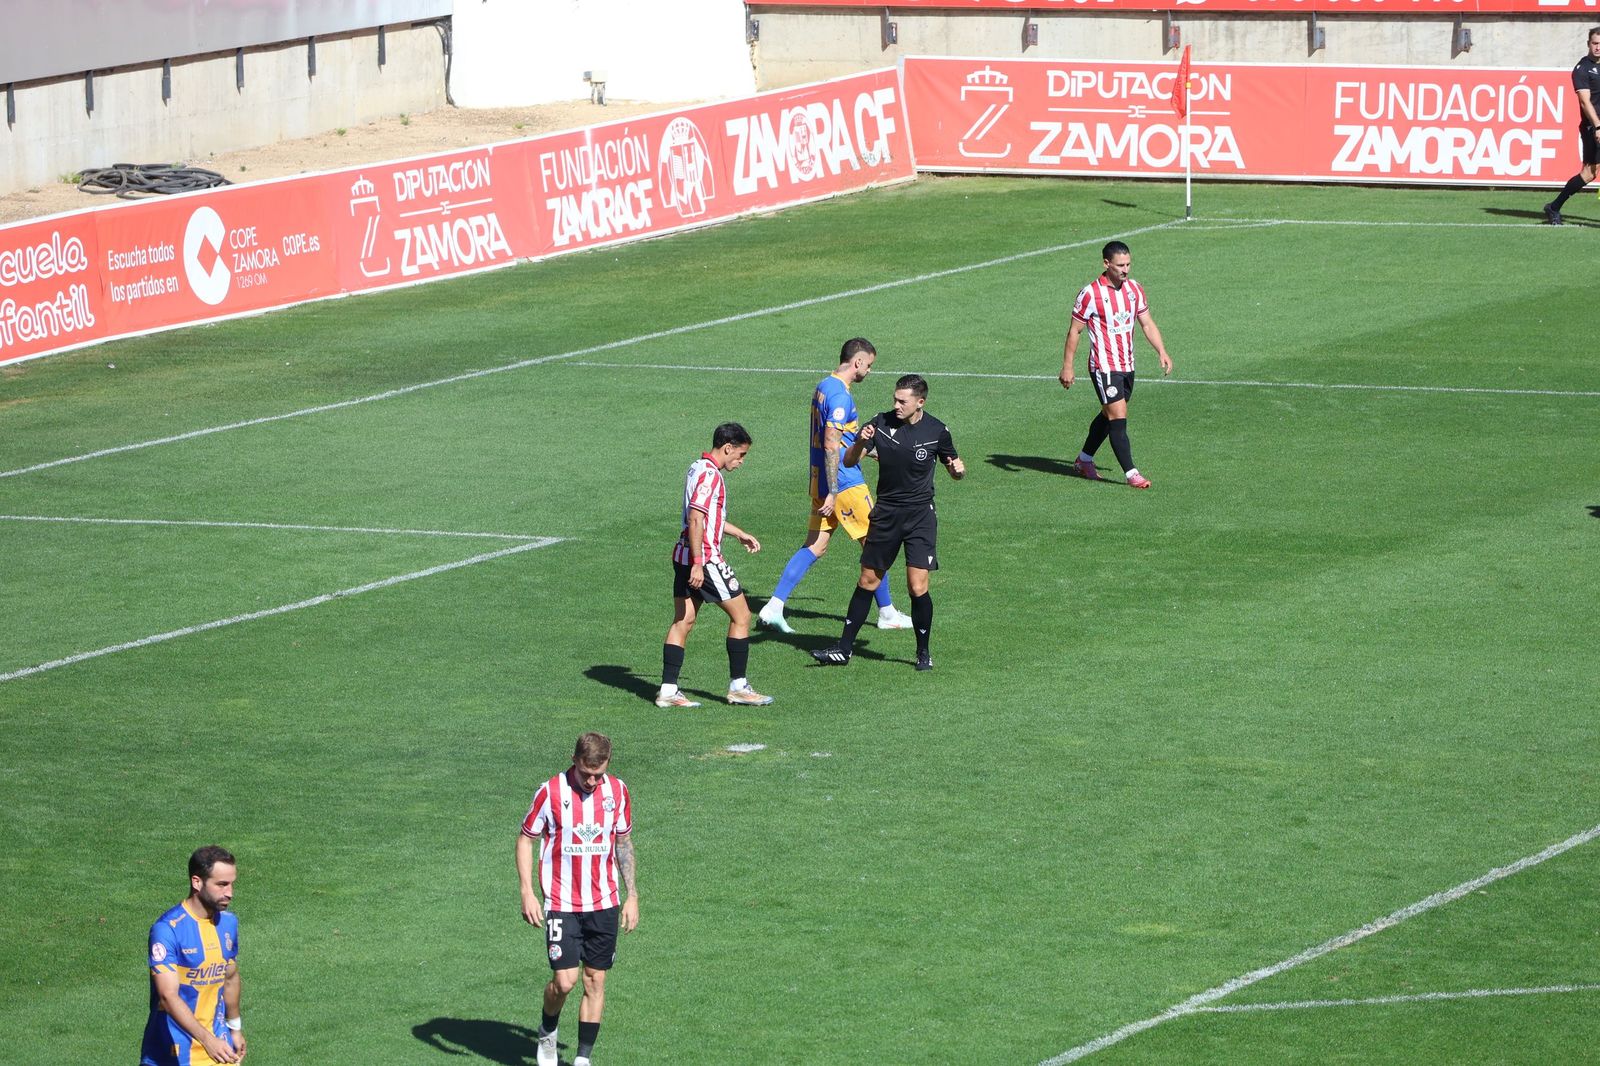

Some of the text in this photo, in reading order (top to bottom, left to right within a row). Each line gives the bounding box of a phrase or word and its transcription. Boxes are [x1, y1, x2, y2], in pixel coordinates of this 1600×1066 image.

[1334, 75, 1564, 123] FUNDACIÓN
[725, 87, 896, 195] ZAMORA CF
[1028, 120, 1246, 169] ZAMORA
[539, 127, 651, 193] FUNDACIÓN
[229, 226, 258, 250] COPE
[282, 233, 320, 256] COPE.es
[394, 213, 512, 276] ZAMORA
[107, 240, 176, 271] Escucha todos
[232, 247, 280, 273] ZAMORA
[110, 274, 179, 304] los partidos en
[236, 274, 253, 288] 1269
[547, 918, 563, 942] 15
